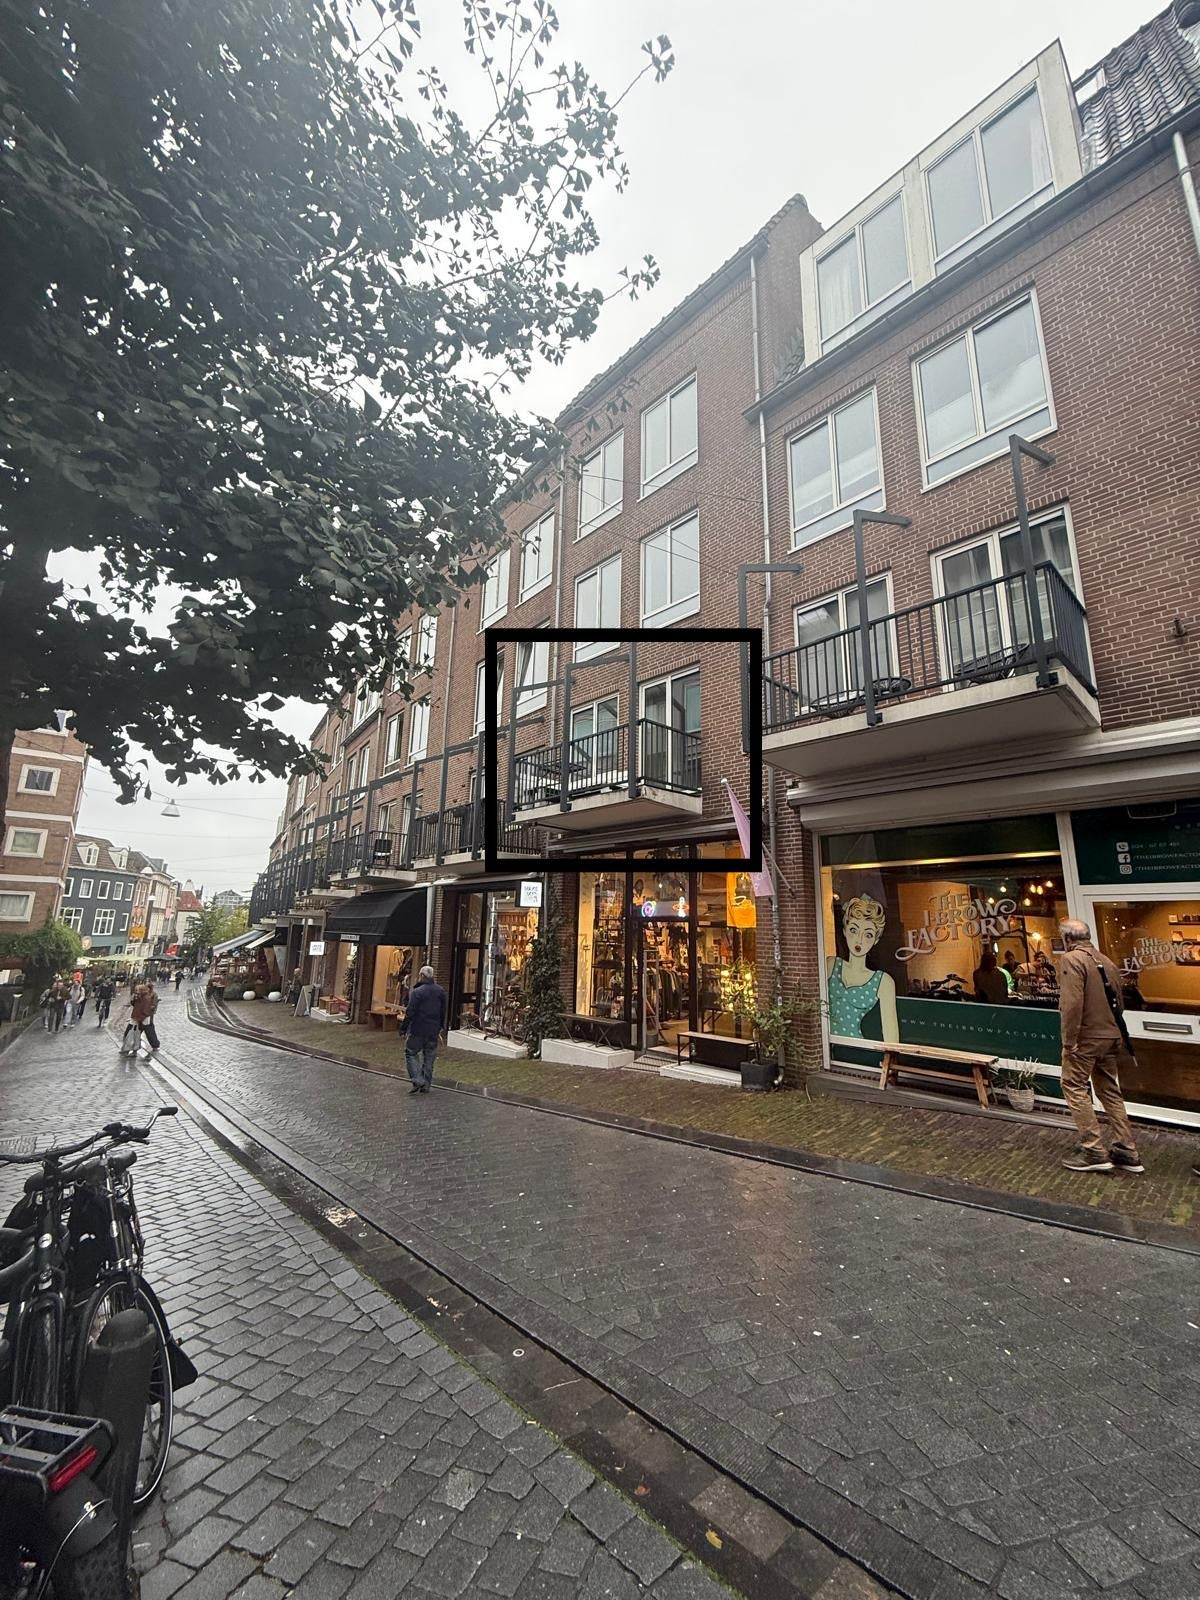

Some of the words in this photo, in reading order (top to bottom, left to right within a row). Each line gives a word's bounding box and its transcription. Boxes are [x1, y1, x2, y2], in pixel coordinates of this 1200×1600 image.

[928, 889, 969, 911] THE
[895, 915, 1012, 961] FACTORY
[1136, 938, 1163, 947] THE
